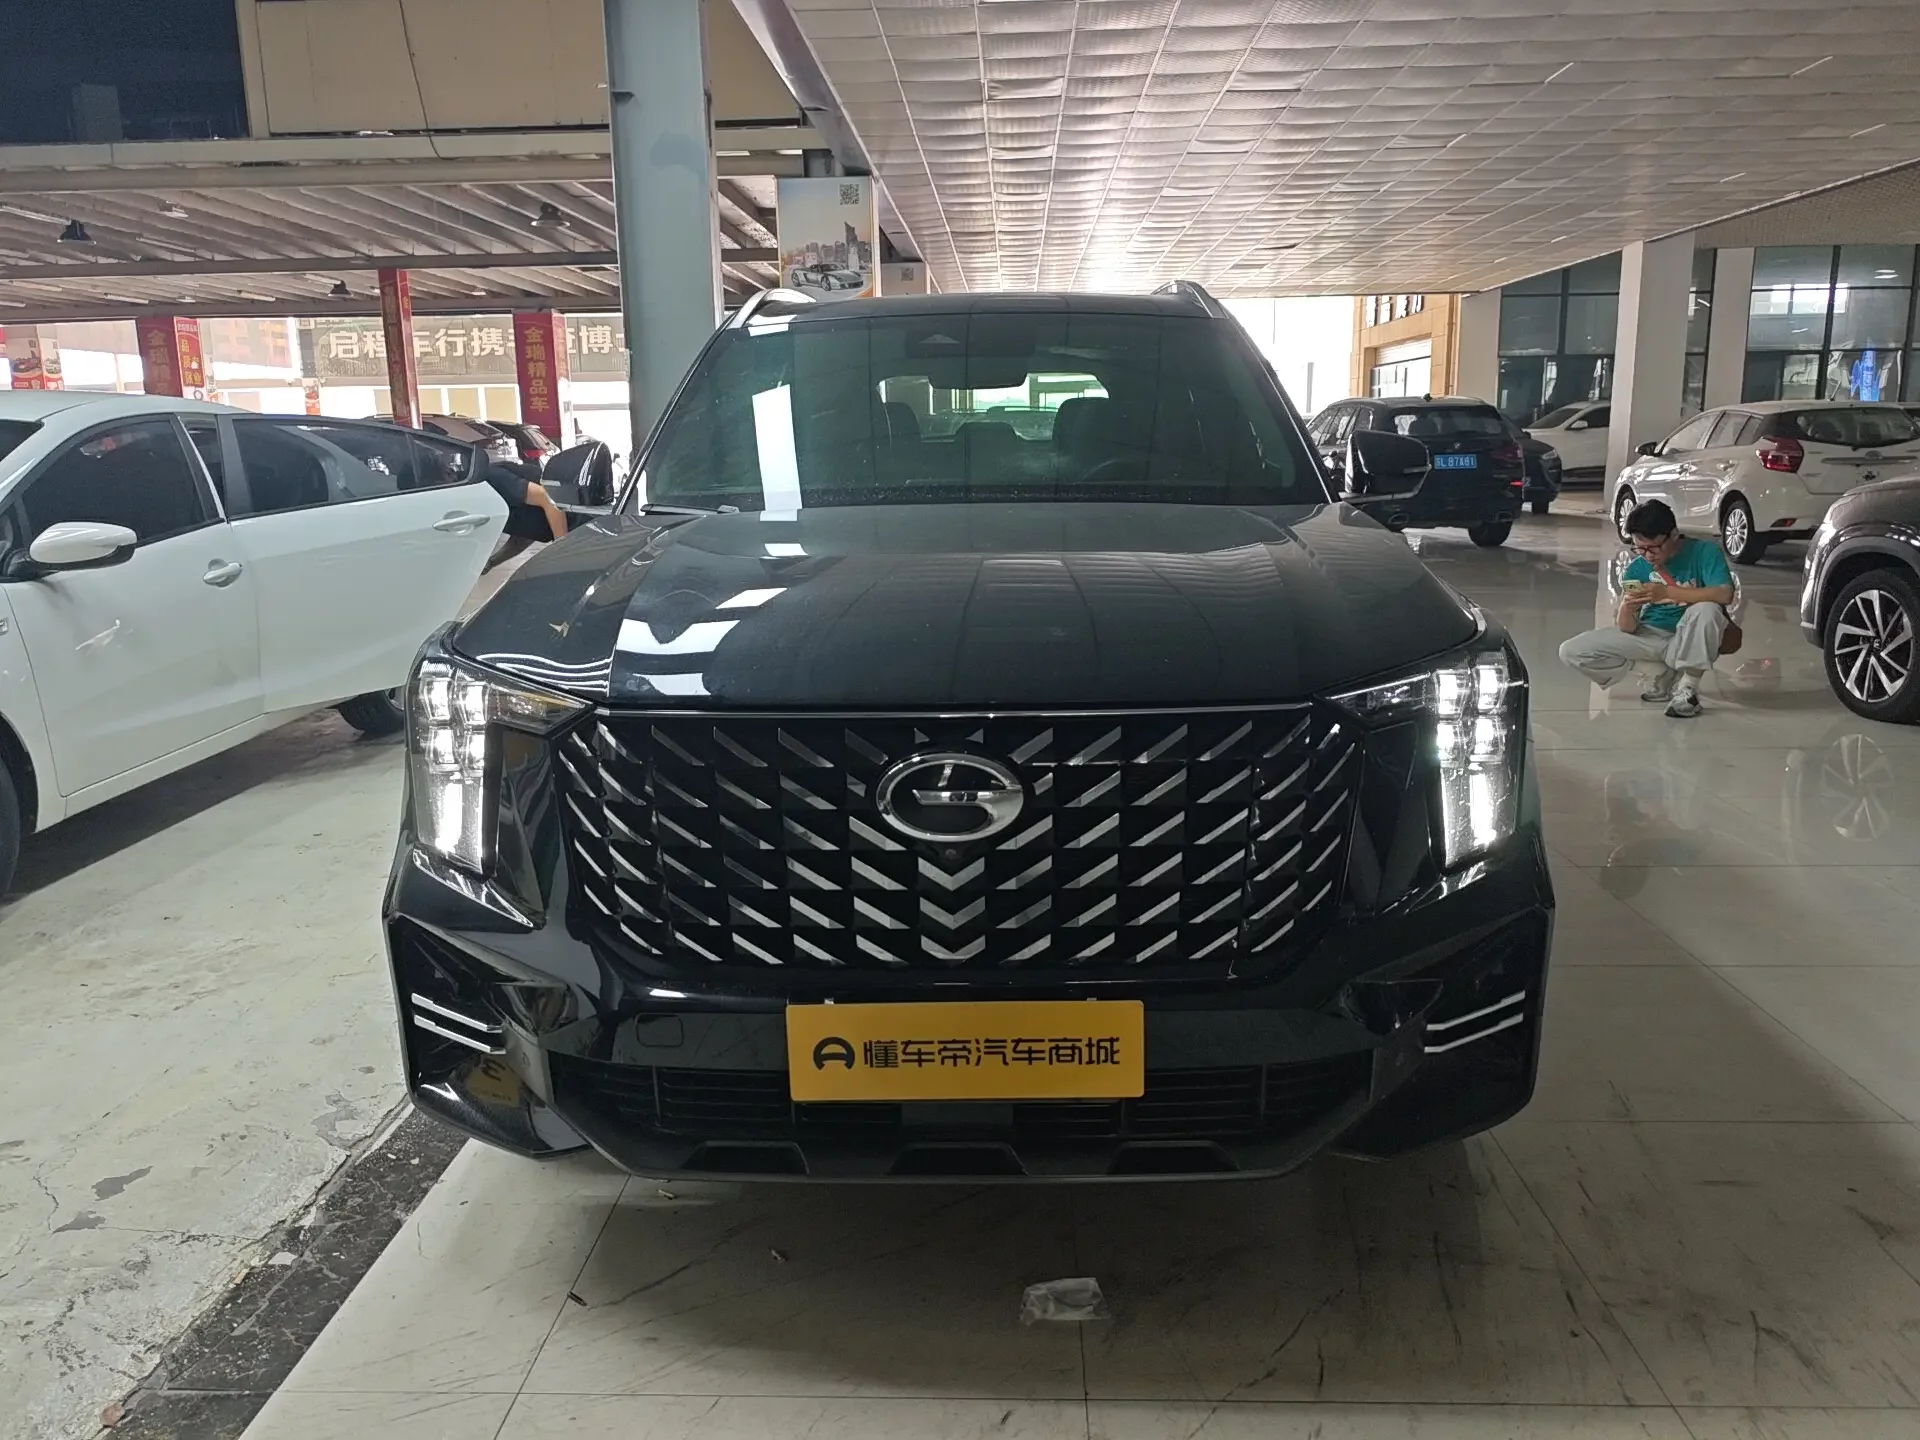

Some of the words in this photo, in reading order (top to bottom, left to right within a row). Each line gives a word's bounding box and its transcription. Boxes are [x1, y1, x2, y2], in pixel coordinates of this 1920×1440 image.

[523, 326, 550, 413] 金瑞精品车
[863, 1036, 1121, 1068] 懂车帝汽车商城
